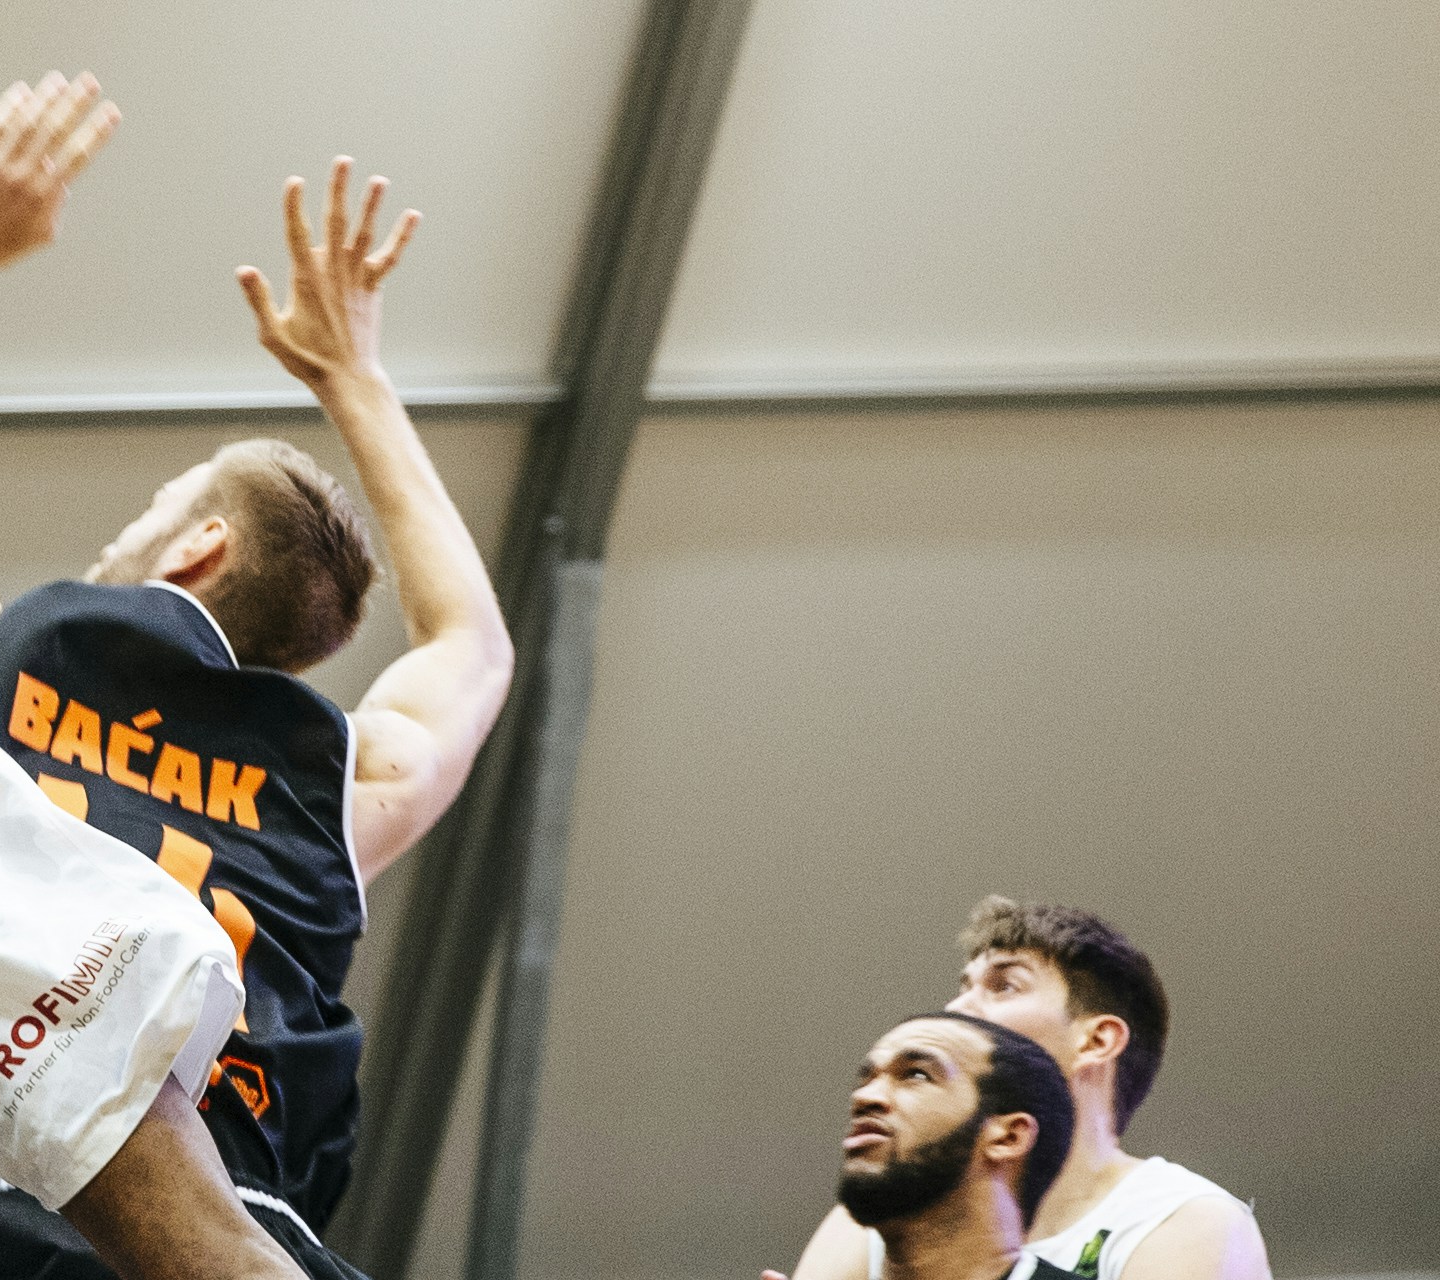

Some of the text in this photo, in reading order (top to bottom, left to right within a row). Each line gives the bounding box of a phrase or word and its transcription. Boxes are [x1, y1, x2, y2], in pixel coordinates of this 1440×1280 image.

[7, 669, 268, 833] BAĆAK
[3, 1098, 19, 1120] Ihr
[13, 1050, 58, 1102] Partner
[53, 1032, 75, 1053] für
